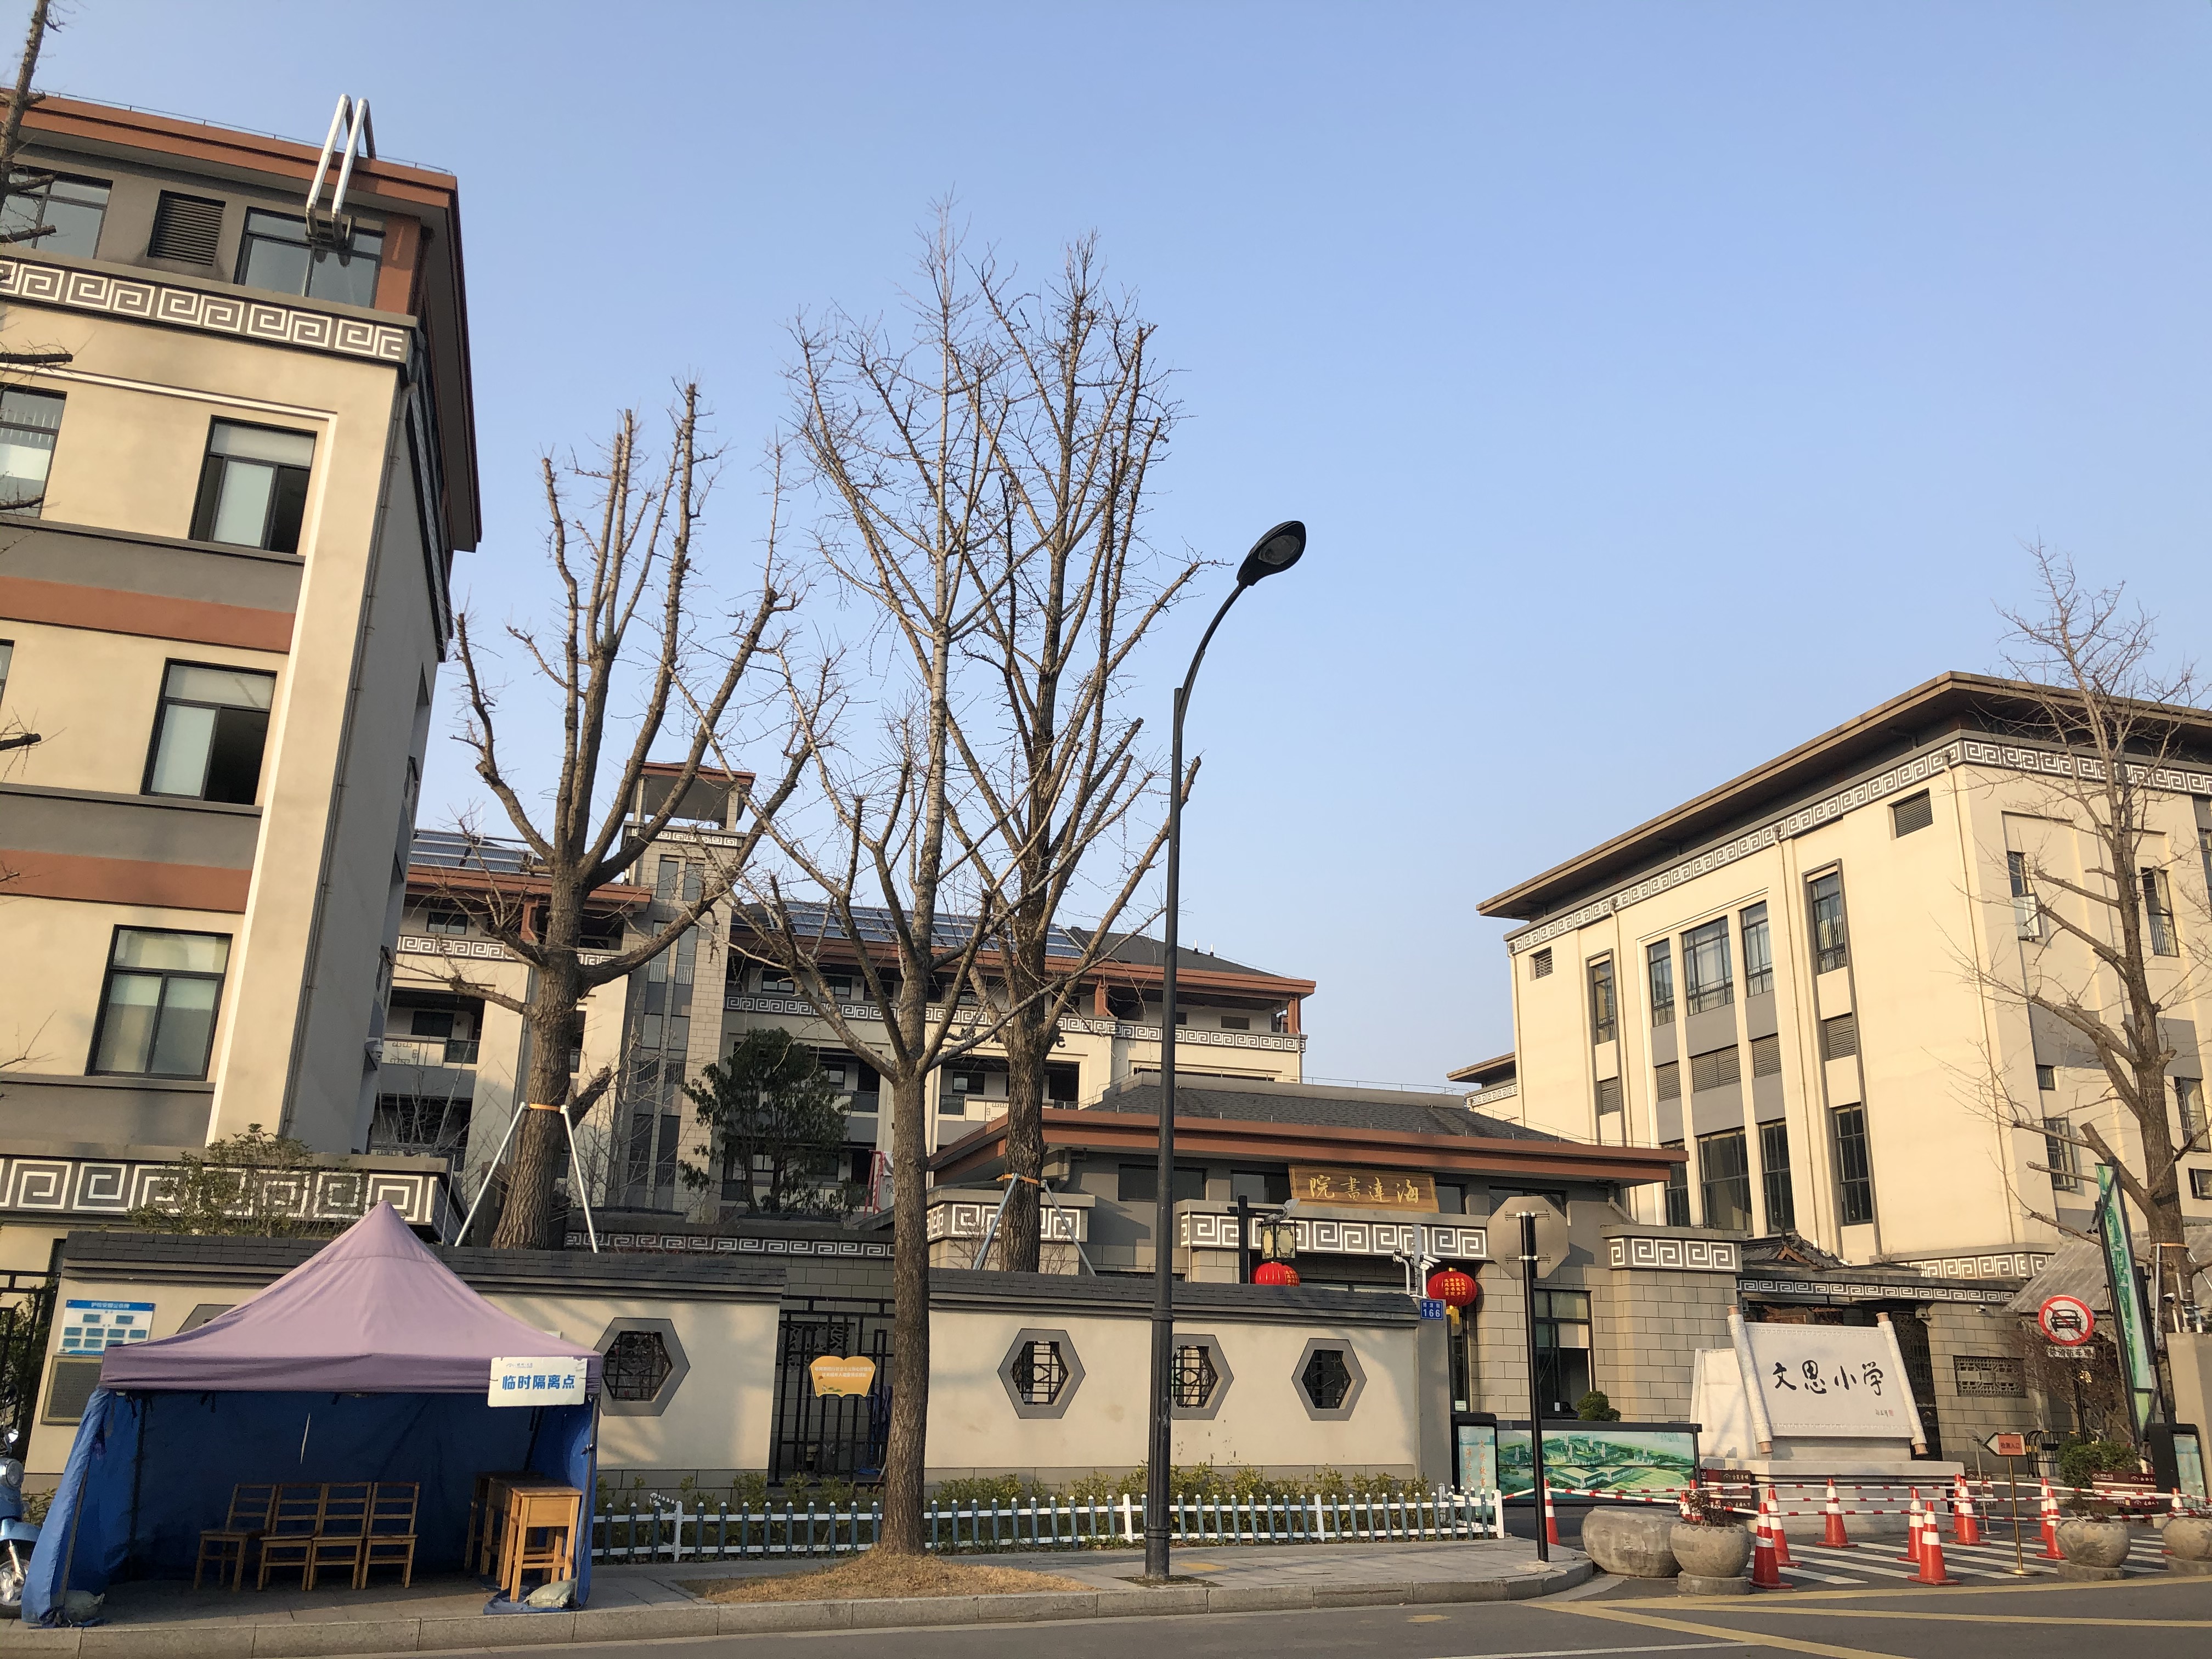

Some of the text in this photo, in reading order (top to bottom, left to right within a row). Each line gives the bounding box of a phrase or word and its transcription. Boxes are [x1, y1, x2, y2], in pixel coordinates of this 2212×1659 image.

[1423, 1308, 1441, 1317] 166
[502, 1374, 575, 1390] 临时隔离点
